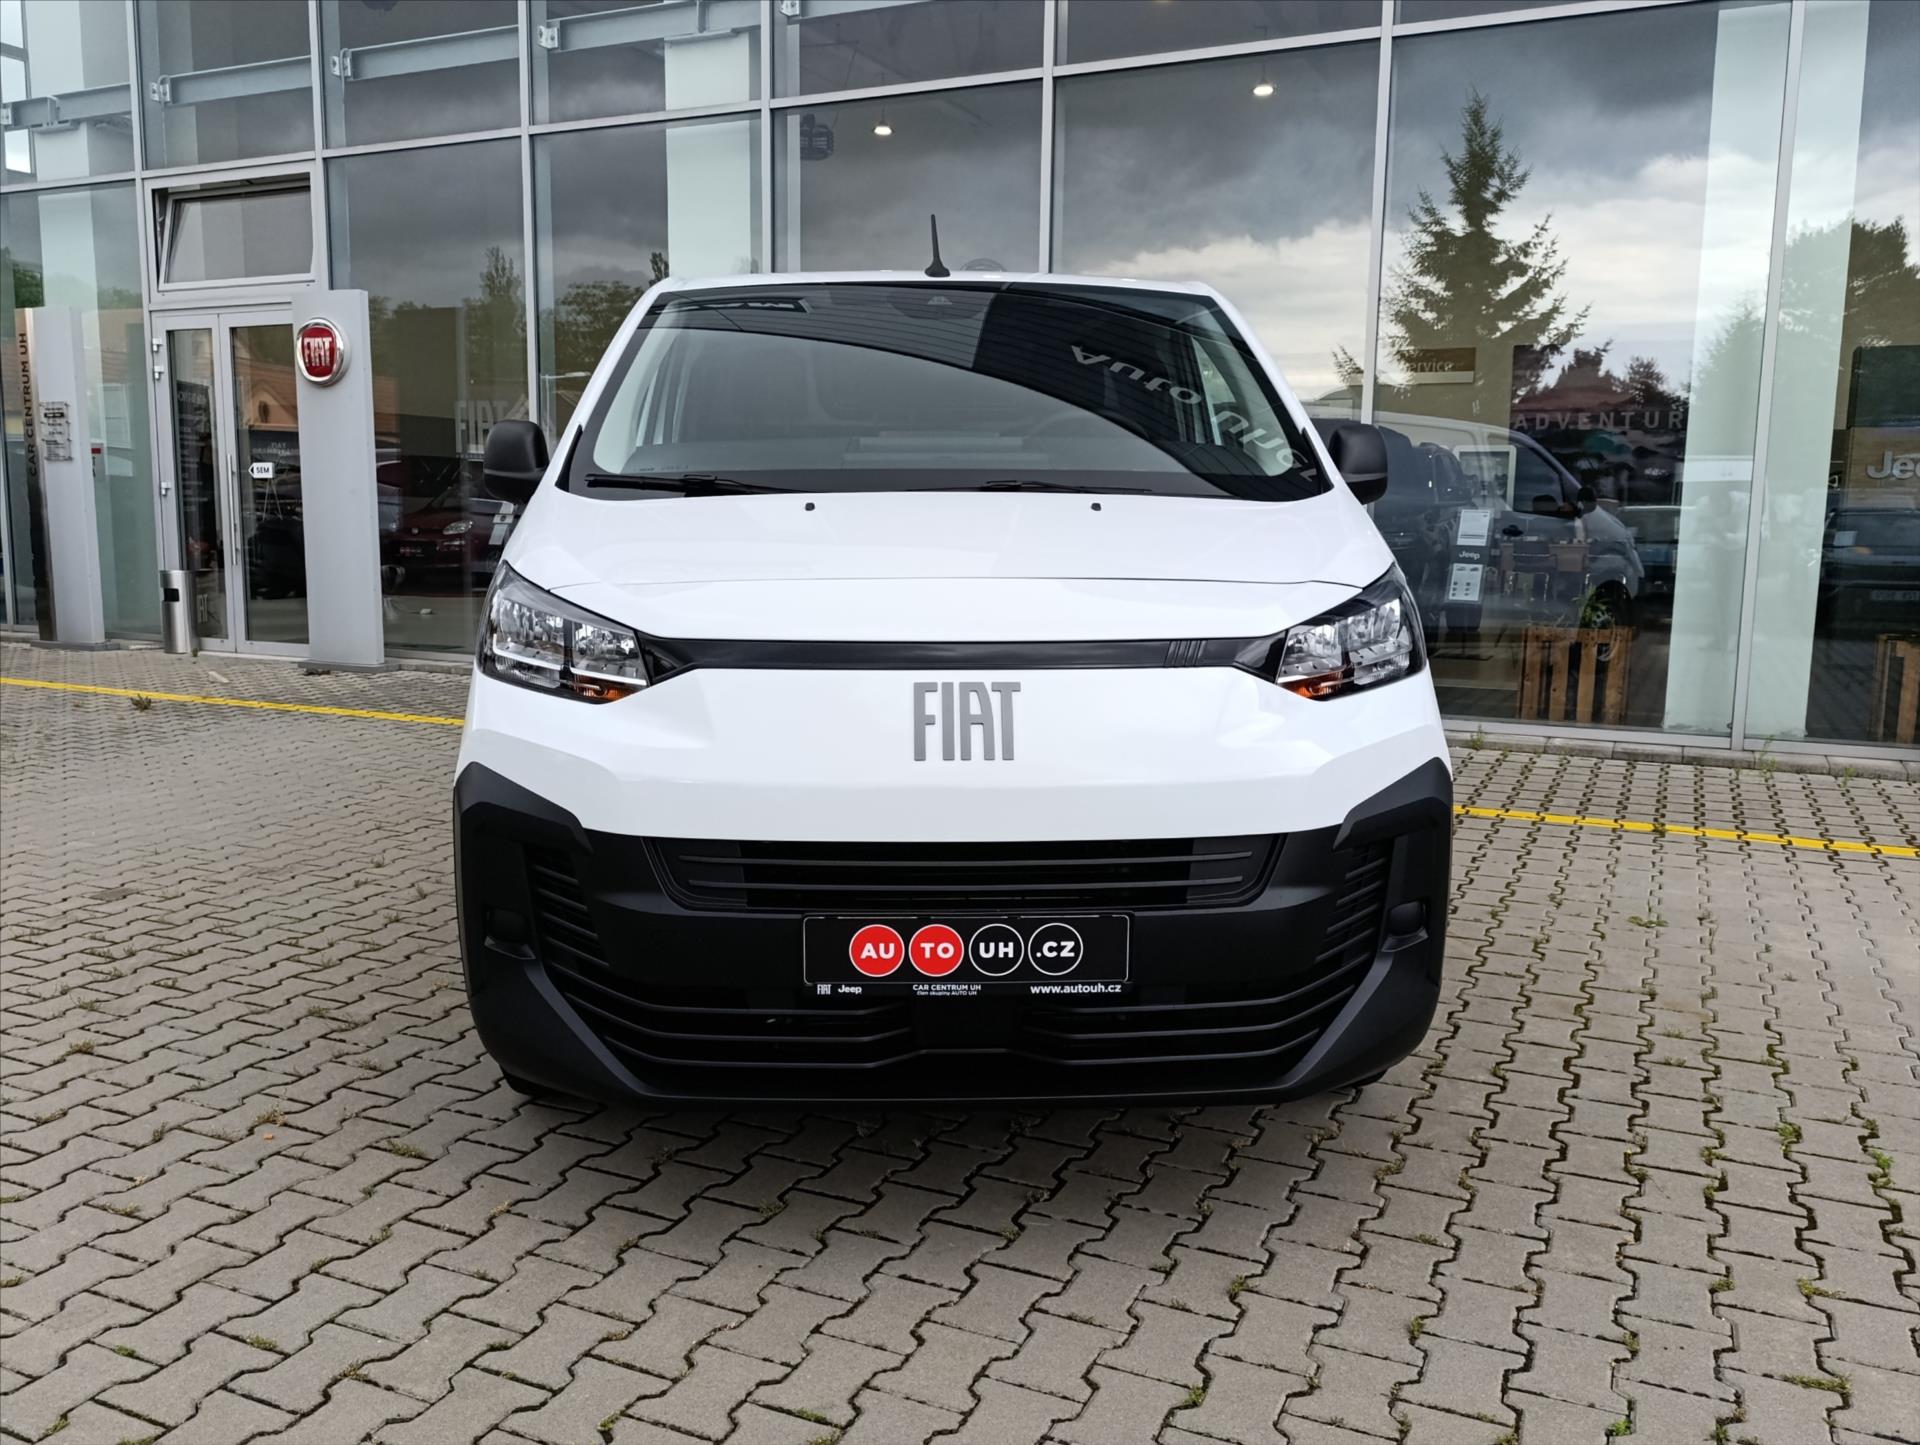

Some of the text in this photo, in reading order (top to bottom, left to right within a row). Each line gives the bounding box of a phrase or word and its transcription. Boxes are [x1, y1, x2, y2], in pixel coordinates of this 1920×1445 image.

[303, 337, 332, 367] FIAT
[1404, 358, 1455, 372] ervice
[18, 333, 38, 477] CAR CENTRUM UH
[255, 466, 270, 474] SEM
[1458, 550, 1481, 560] Jeep
[913, 681, 1021, 761] FIAT
[860, 940, 1075, 959] AU TO UH .CZ
[817, 984, 863, 995] FIAT Jeep
[1030, 983, 1122, 995] www.autouh.cz
